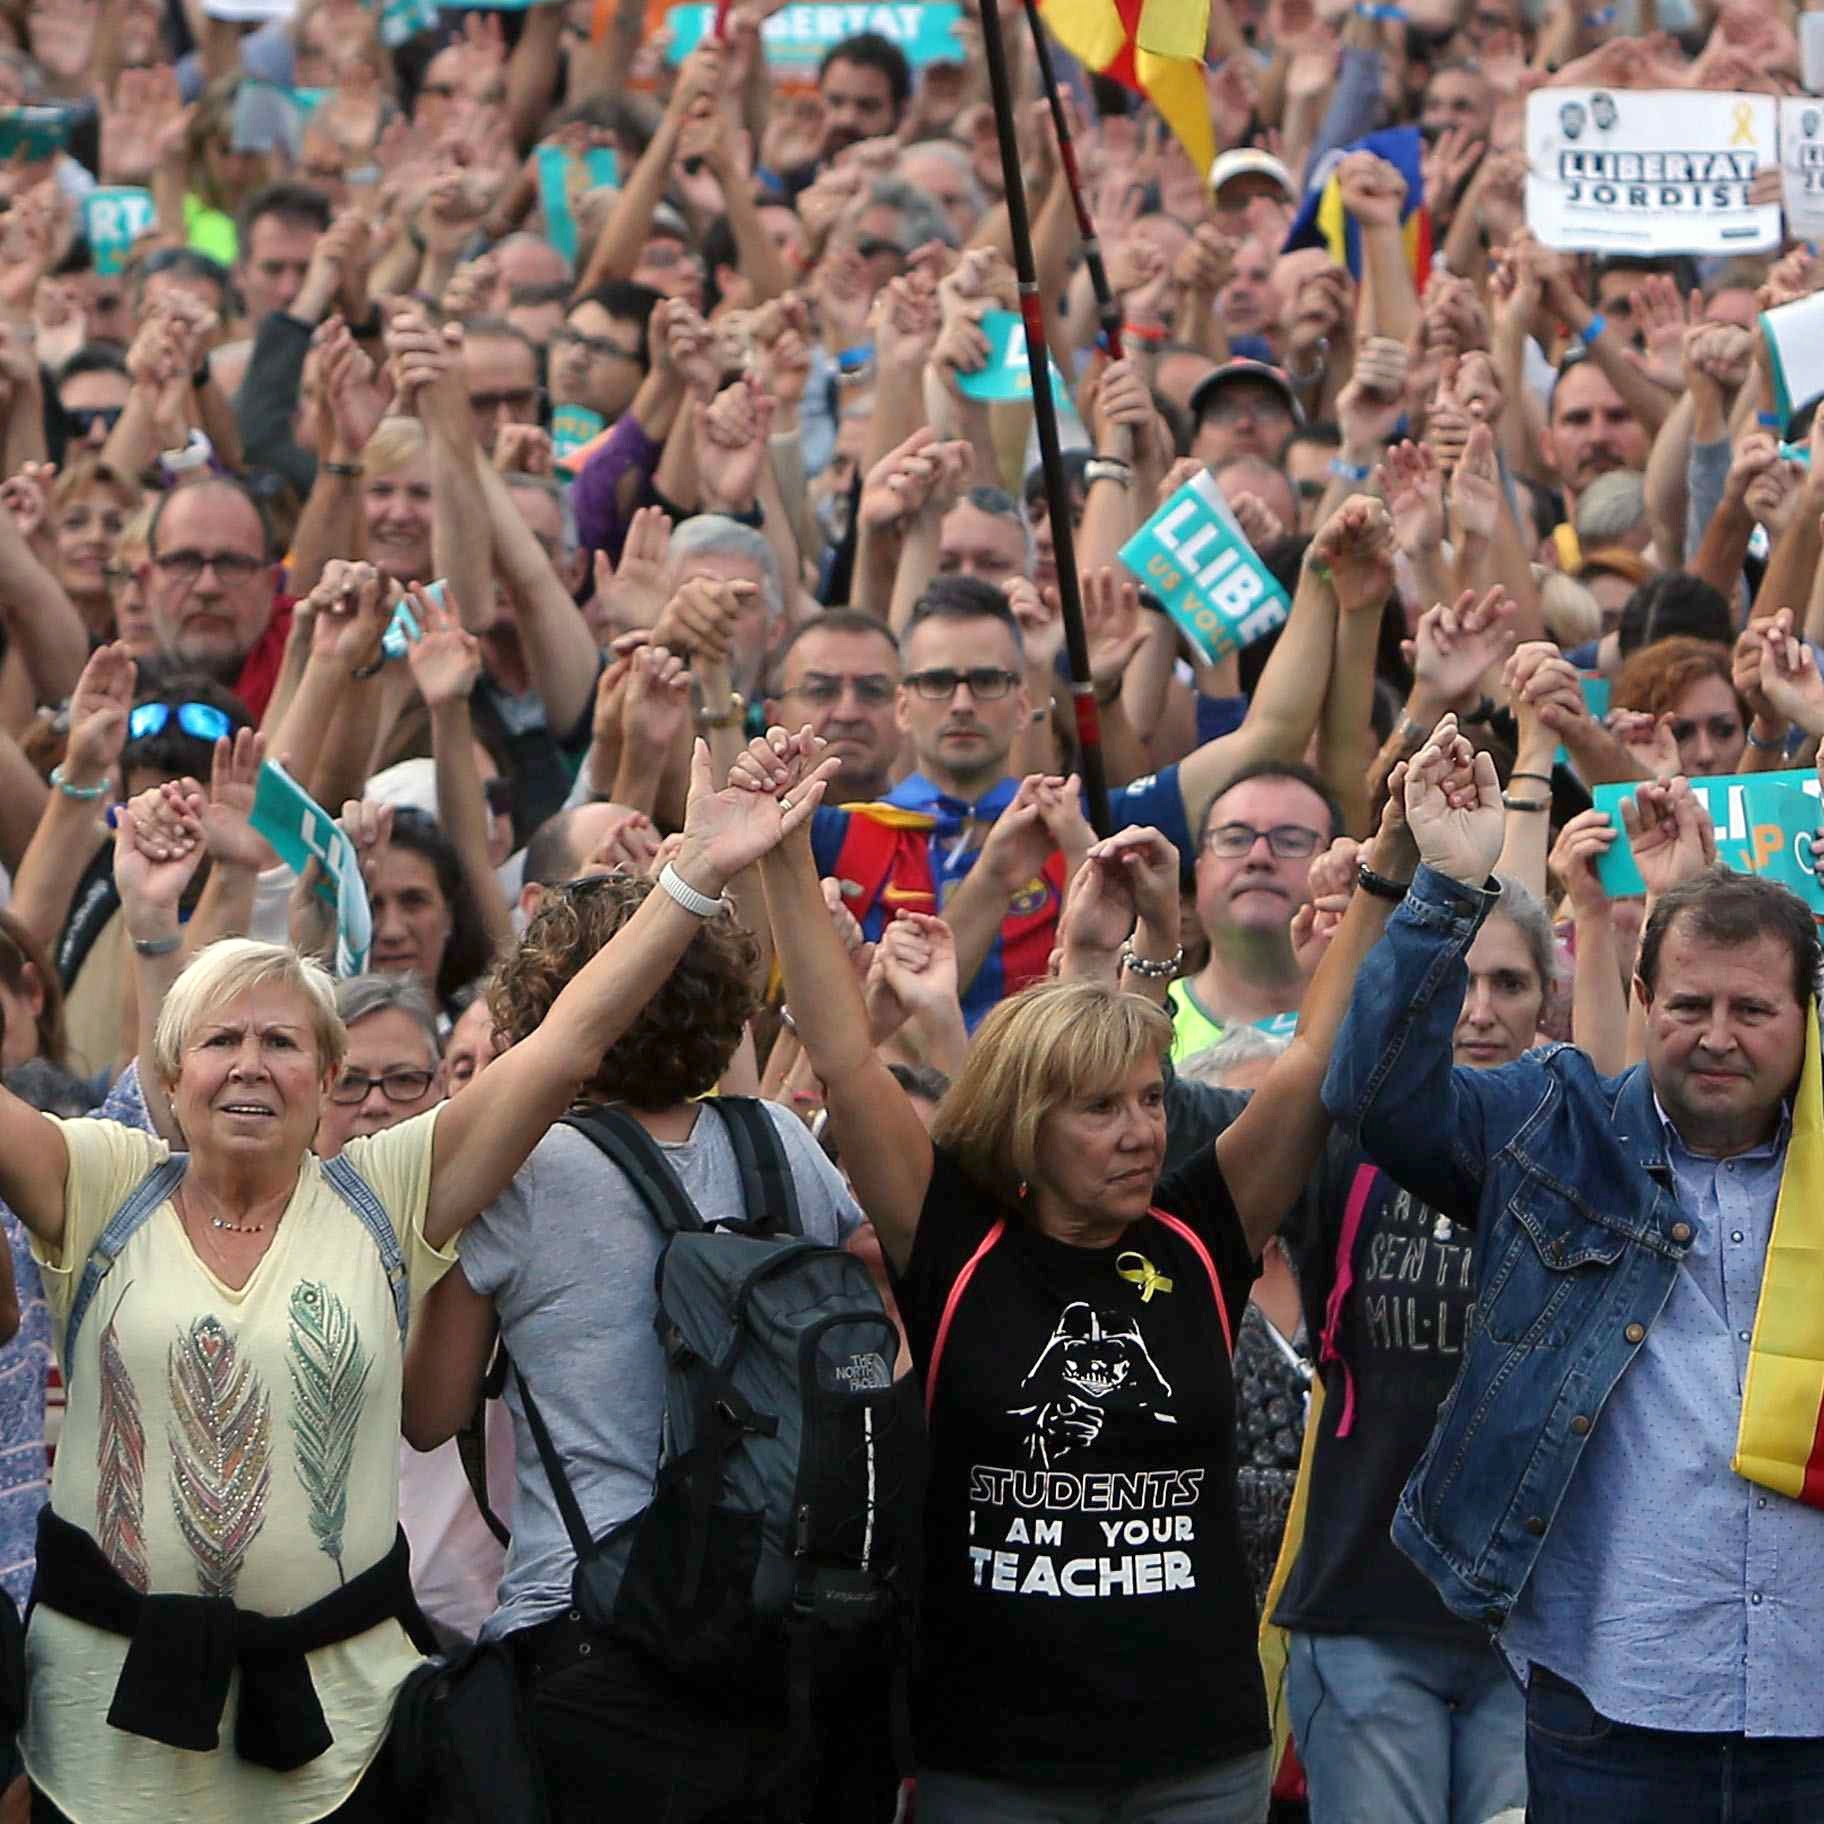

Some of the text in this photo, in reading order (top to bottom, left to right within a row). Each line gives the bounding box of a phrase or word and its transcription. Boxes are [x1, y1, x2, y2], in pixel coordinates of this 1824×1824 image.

[1561, 151, 1759, 183] LLIBERTAT
[1152, 498, 1289, 646] LLIBE
[836, 1365, 874, 1380] NORTH
[849, 1354, 874, 1368] THE
[849, 1377, 881, 1392] FACE
[970, 1465, 1205, 1512] STUDENTS
[969, 1510, 1195, 1548] I AM YOUR
[969, 1545, 1196, 1597] TEACHER
